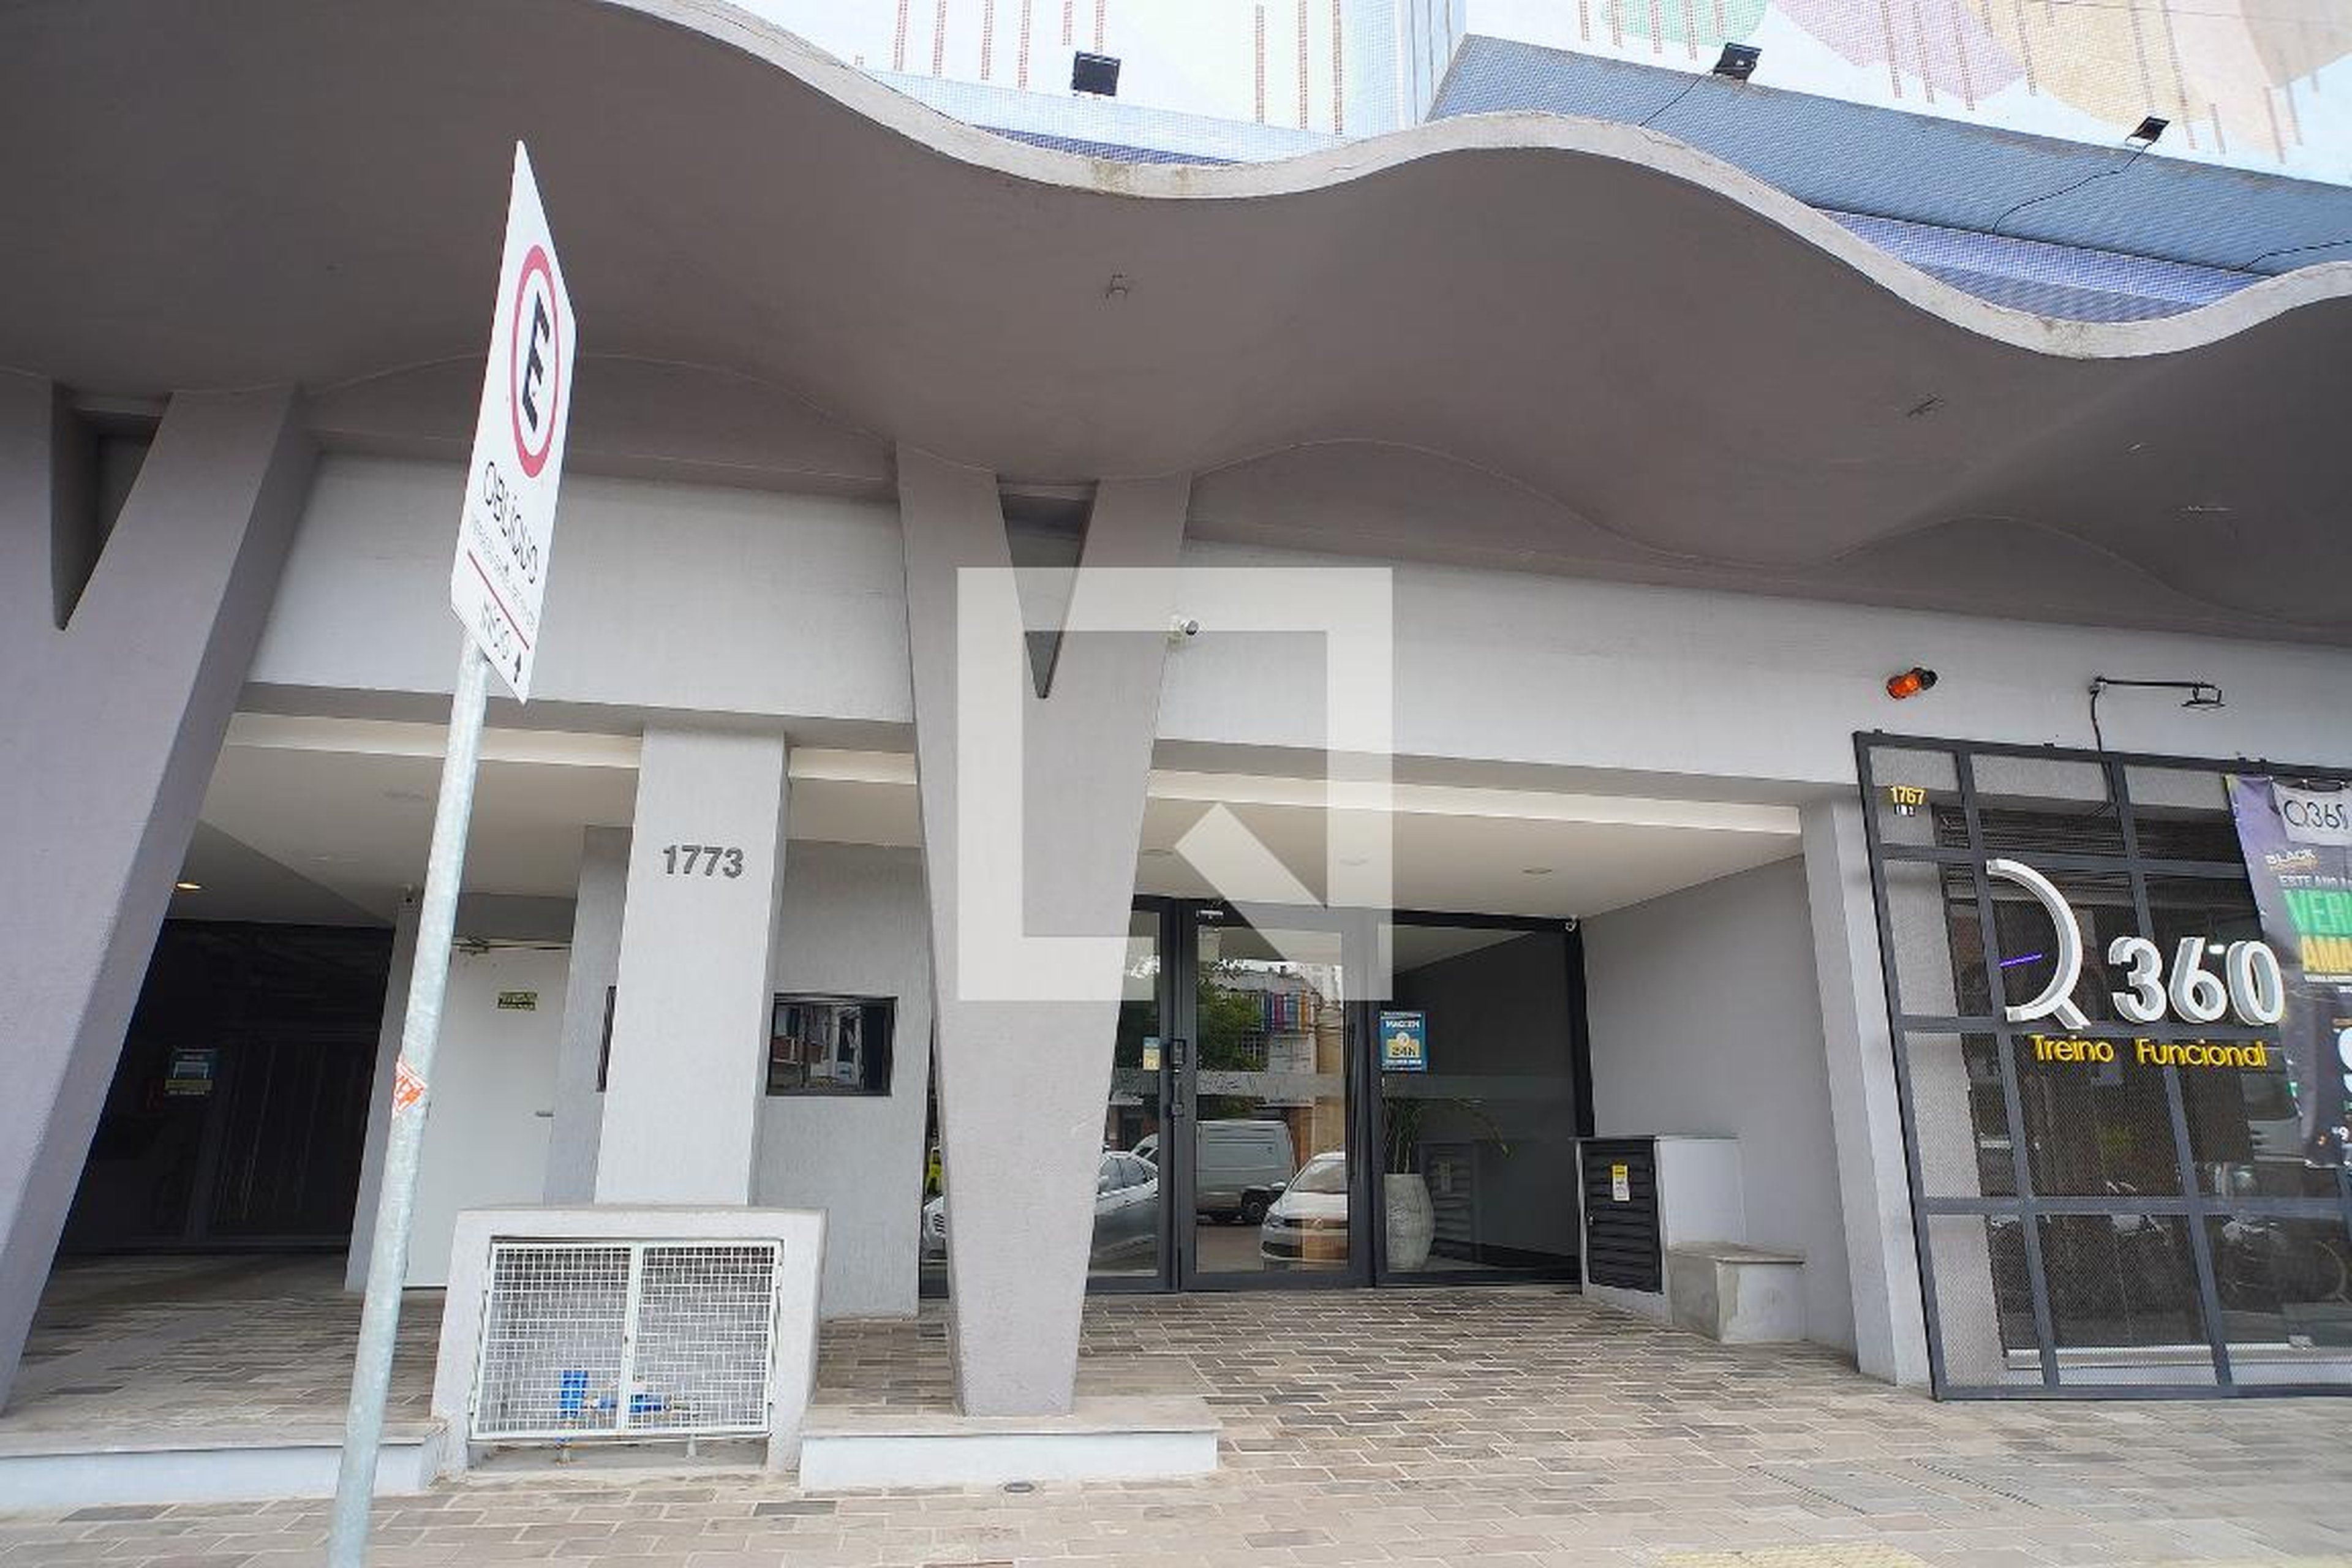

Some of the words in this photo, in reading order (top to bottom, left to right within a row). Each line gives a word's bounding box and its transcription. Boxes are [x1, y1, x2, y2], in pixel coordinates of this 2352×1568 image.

[522, 290, 550, 432] E
[1890, 785, 1925, 805] 1767
[663, 845, 744, 878] 1773
[2029, 1035, 2114, 1063] Treino
[2135, 1038, 2267, 1067] Funcional
